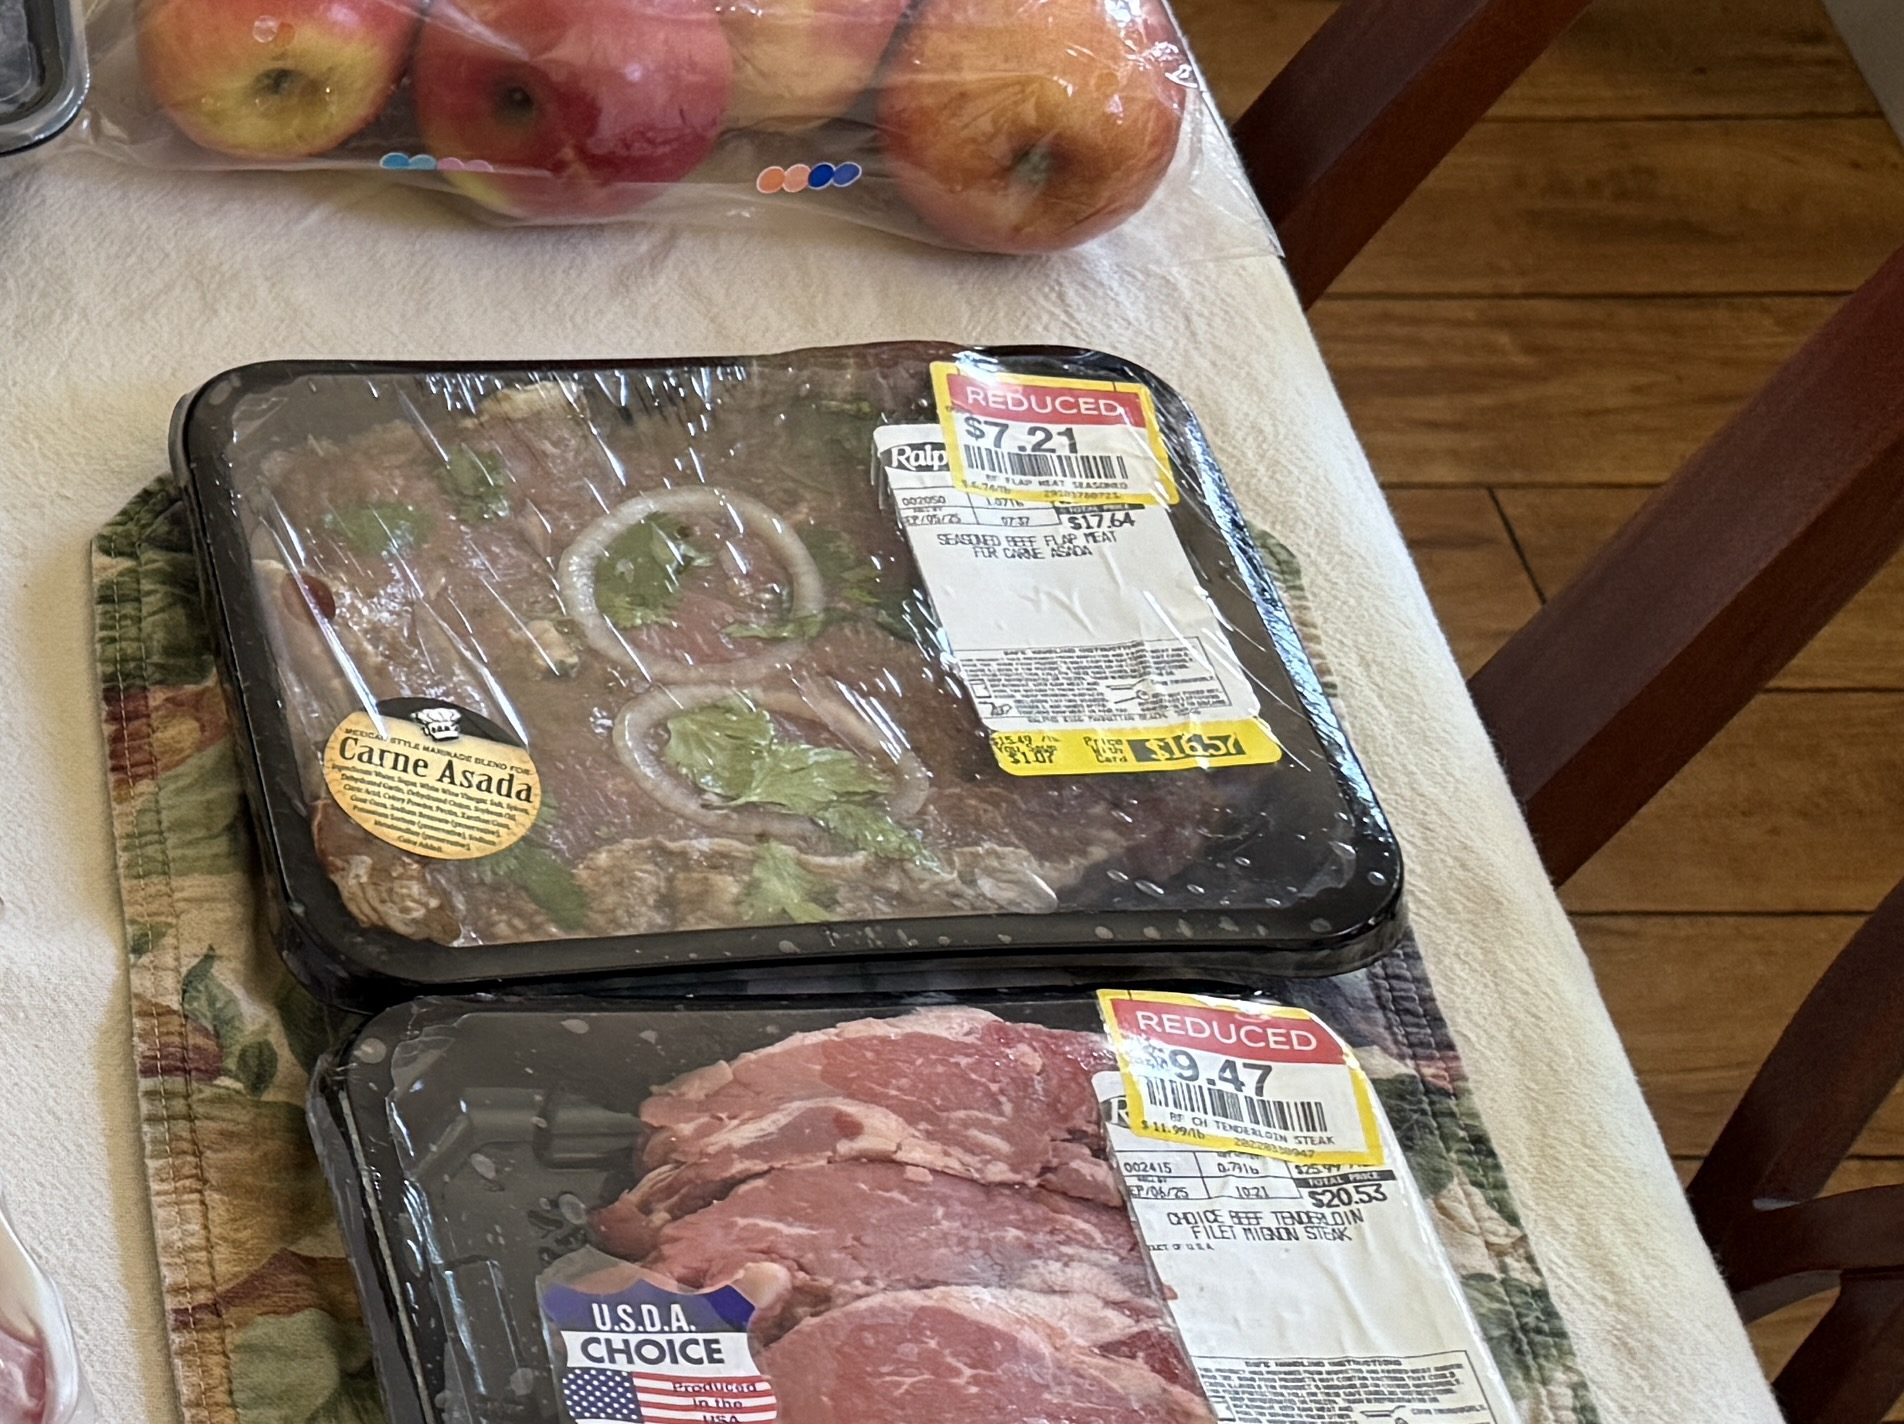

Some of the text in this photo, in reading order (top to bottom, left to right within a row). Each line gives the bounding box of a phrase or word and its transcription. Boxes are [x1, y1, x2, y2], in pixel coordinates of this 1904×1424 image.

[966, 386, 1121, 418] REDUCED
[964, 415, 1079, 455] $7.21
[1067, 513, 1136, 530] $17.64
[337, 730, 536, 804] Carne Asada
[1136, 1010, 1318, 1053] REDUCED
[1308, 1184, 1387, 1209] $20.53
[1168, 1209, 1363, 1227] CHOICE BEEF TENDERLOIN
[1191, 1225, 1352, 1243] FILET MIGNON STEAK
[590, 1300, 699, 1334] U.S.D.A.
[579, 1333, 725, 1368] CHOICE
